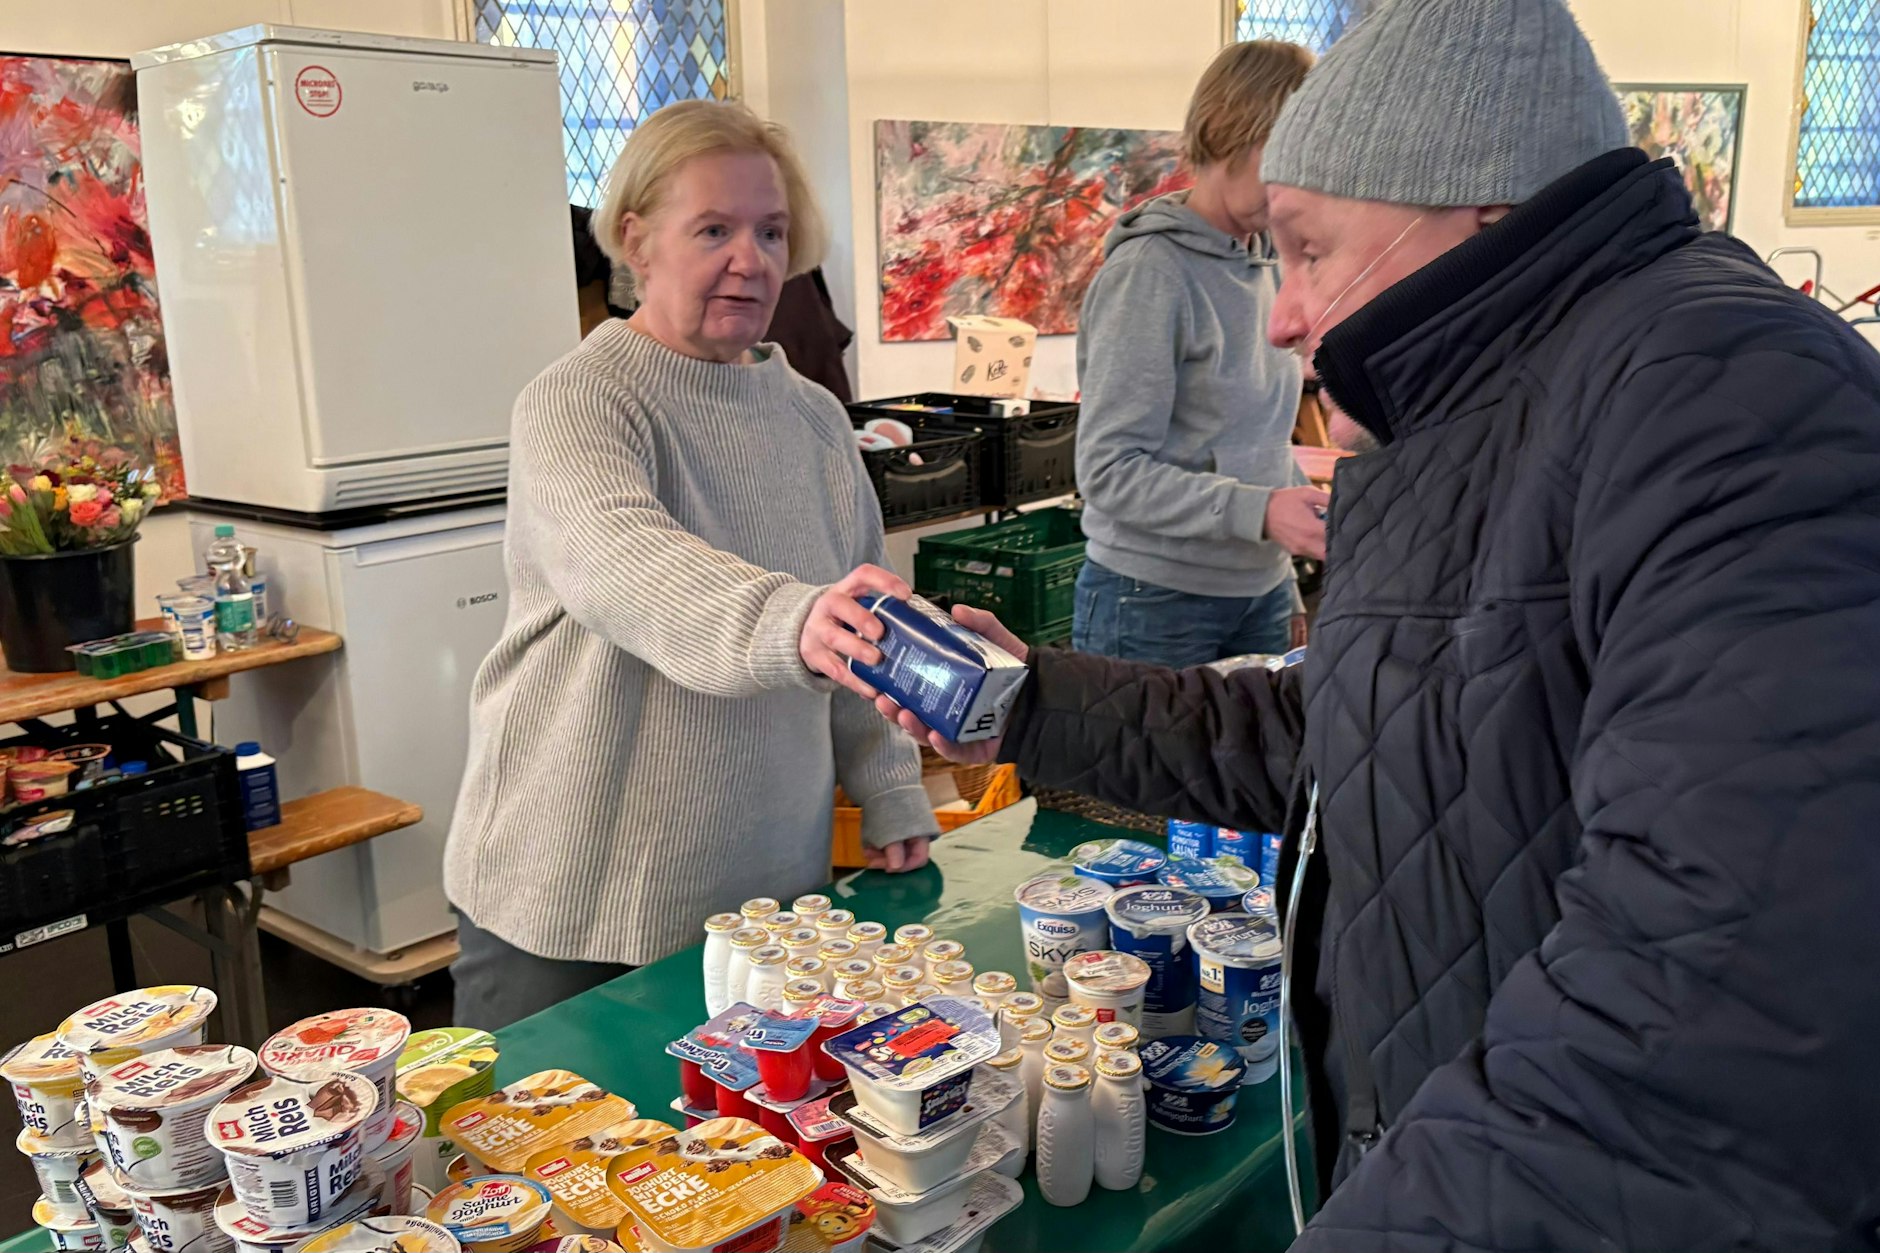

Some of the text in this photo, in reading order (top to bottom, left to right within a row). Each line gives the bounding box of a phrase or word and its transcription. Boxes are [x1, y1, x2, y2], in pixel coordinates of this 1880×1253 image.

[469, 592, 498, 605] BOSCH
[1126, 902, 1184, 912] Joghurt
[1037, 920, 1076, 935] Exquisa
[84, 1001, 151, 1030] Milch
[97, 1003, 169, 1034] Reis
[1242, 997, 1281, 1016] Jogh
[113, 1062, 185, 1093] Milch
[129, 1066, 203, 1097] Reis
[244, 1105, 277, 1143] Milch
[271, 1097, 311, 1137] Reis
[472, 1118, 535, 1151] ECKE
[554, 1170, 607, 1202] ECK
[575, 1165, 603, 1181] DER
[624, 1167, 677, 1196] JOGHURT
[632, 1171, 691, 1202] MIT DER
[308, 1169, 319, 1214] ORIGINA
[638, 1174, 710, 1214] ECKE
[452, 1196, 523, 1220] Joghurt
